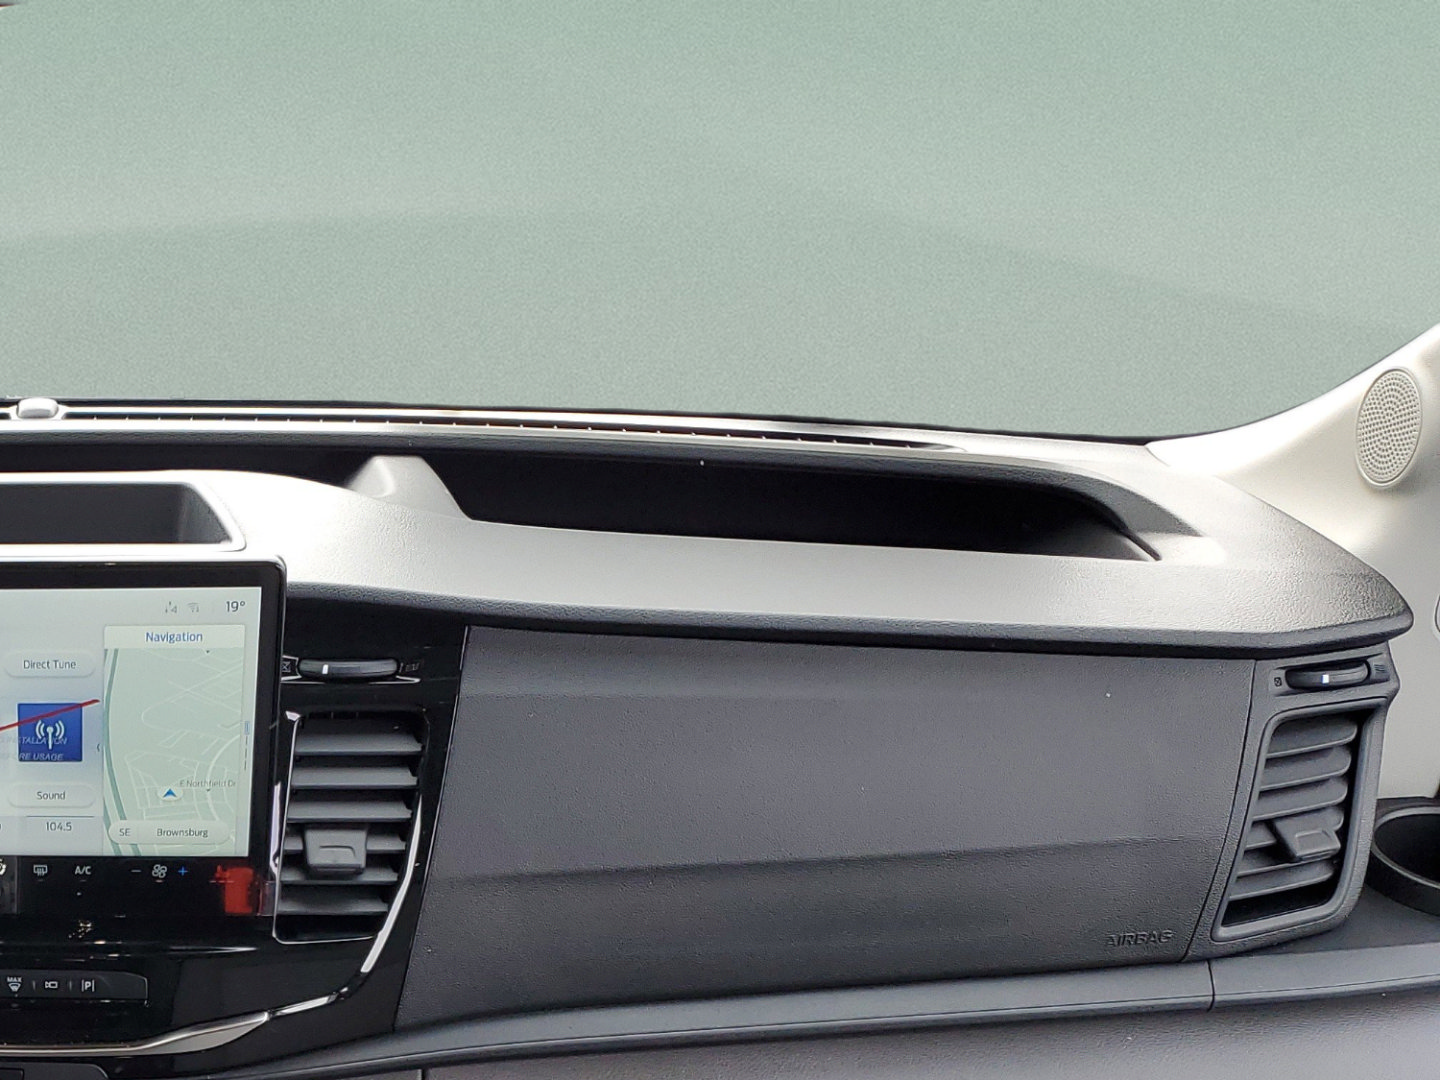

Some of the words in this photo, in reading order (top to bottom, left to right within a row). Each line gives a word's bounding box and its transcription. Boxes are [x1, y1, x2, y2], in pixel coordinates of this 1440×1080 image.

[225, 600, 246, 613] 19°
[145, 631, 203, 645] Navigation
[23, 659, 51, 670] Direct
[52, 659, 77, 670] Tune
[33, 753, 64, 761] USAGE
[179, 779, 185, 788] E
[186, 778, 227, 788] Northfield
[36, 790, 66, 801] Sound
[45, 821, 72, 832] 104.5
[119, 827, 131, 837] SE
[156, 827, 209, 839] Brownsburg
[74, 865, 92, 876] A/C
[1106, 929, 1174, 947] AIRBAG
